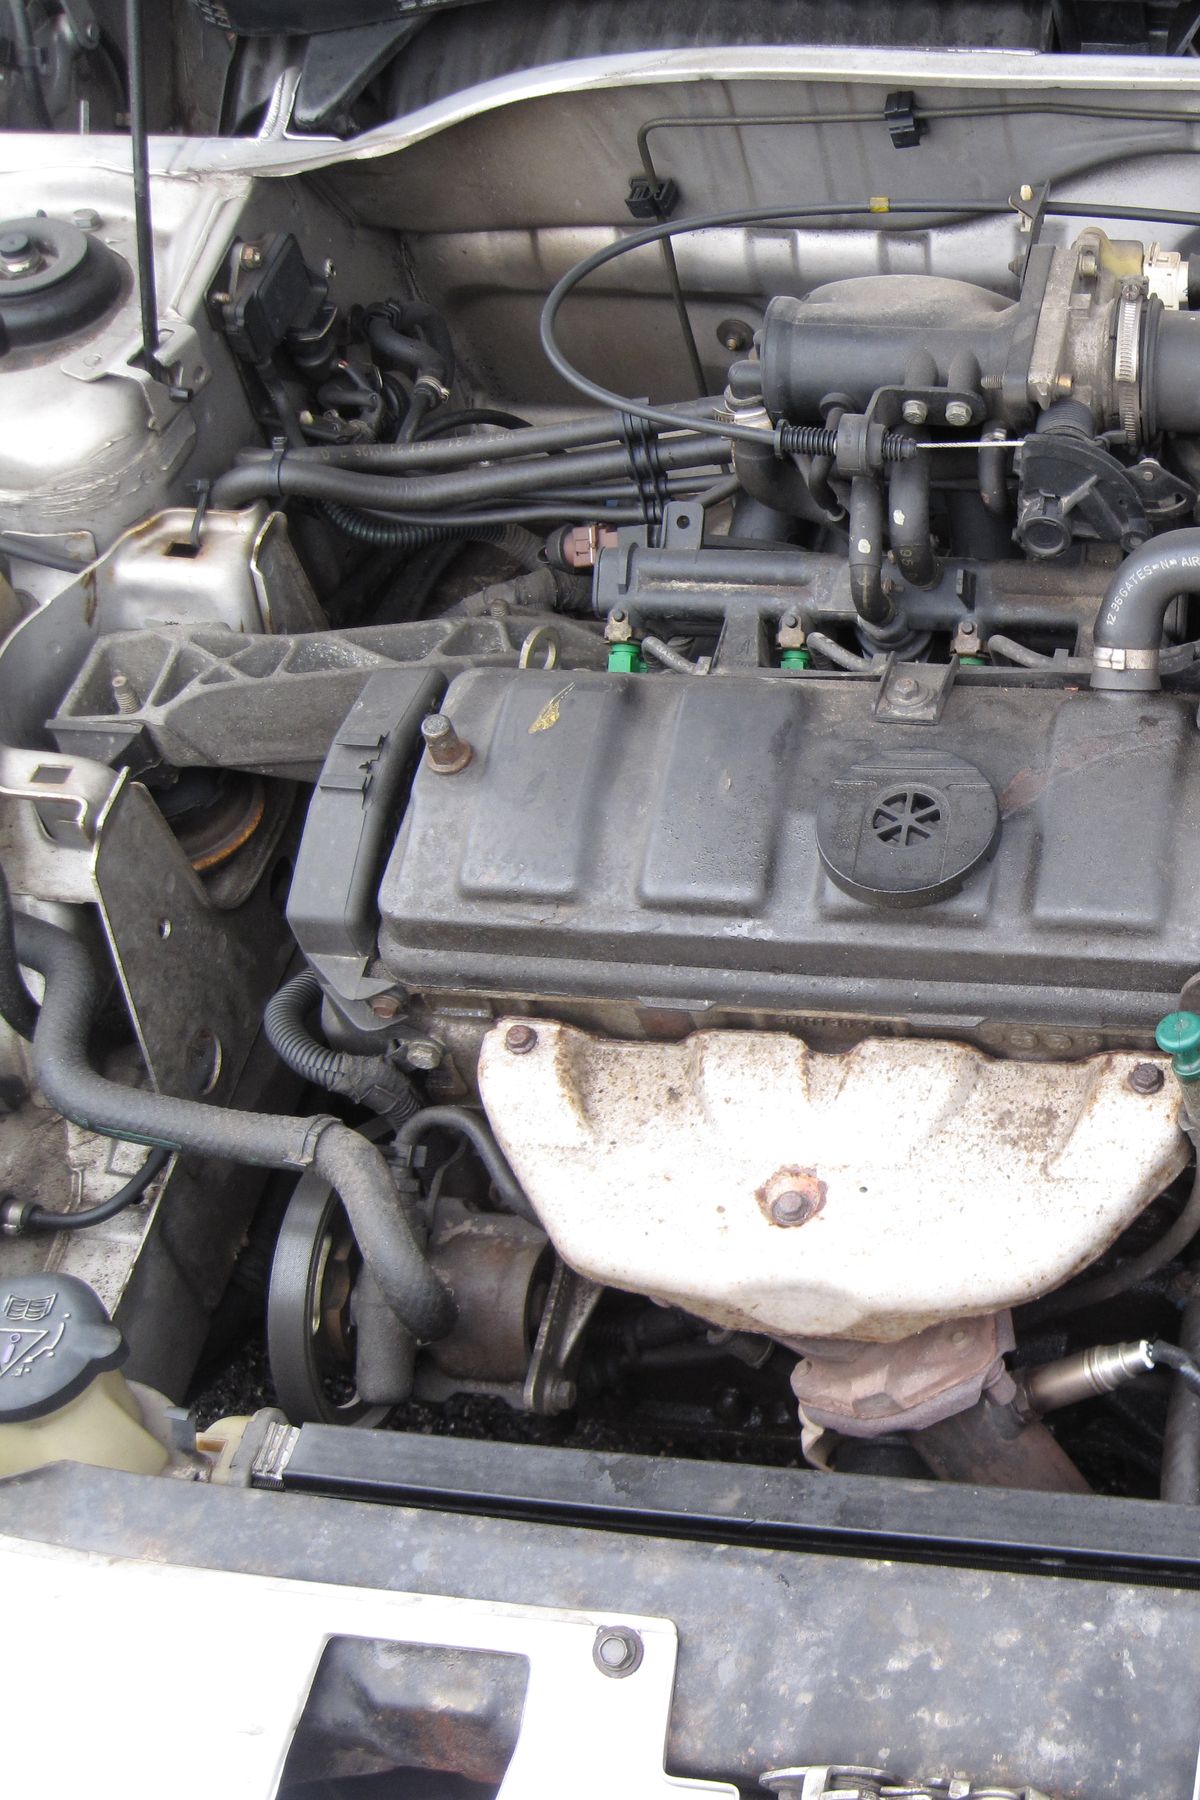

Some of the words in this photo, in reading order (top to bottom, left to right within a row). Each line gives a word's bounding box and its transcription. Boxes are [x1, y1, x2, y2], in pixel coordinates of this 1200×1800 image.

[1181, 556, 1200, 568] AIR
[1111, 596, 1123, 612] 96
[1106, 613, 1117, 625] 12
